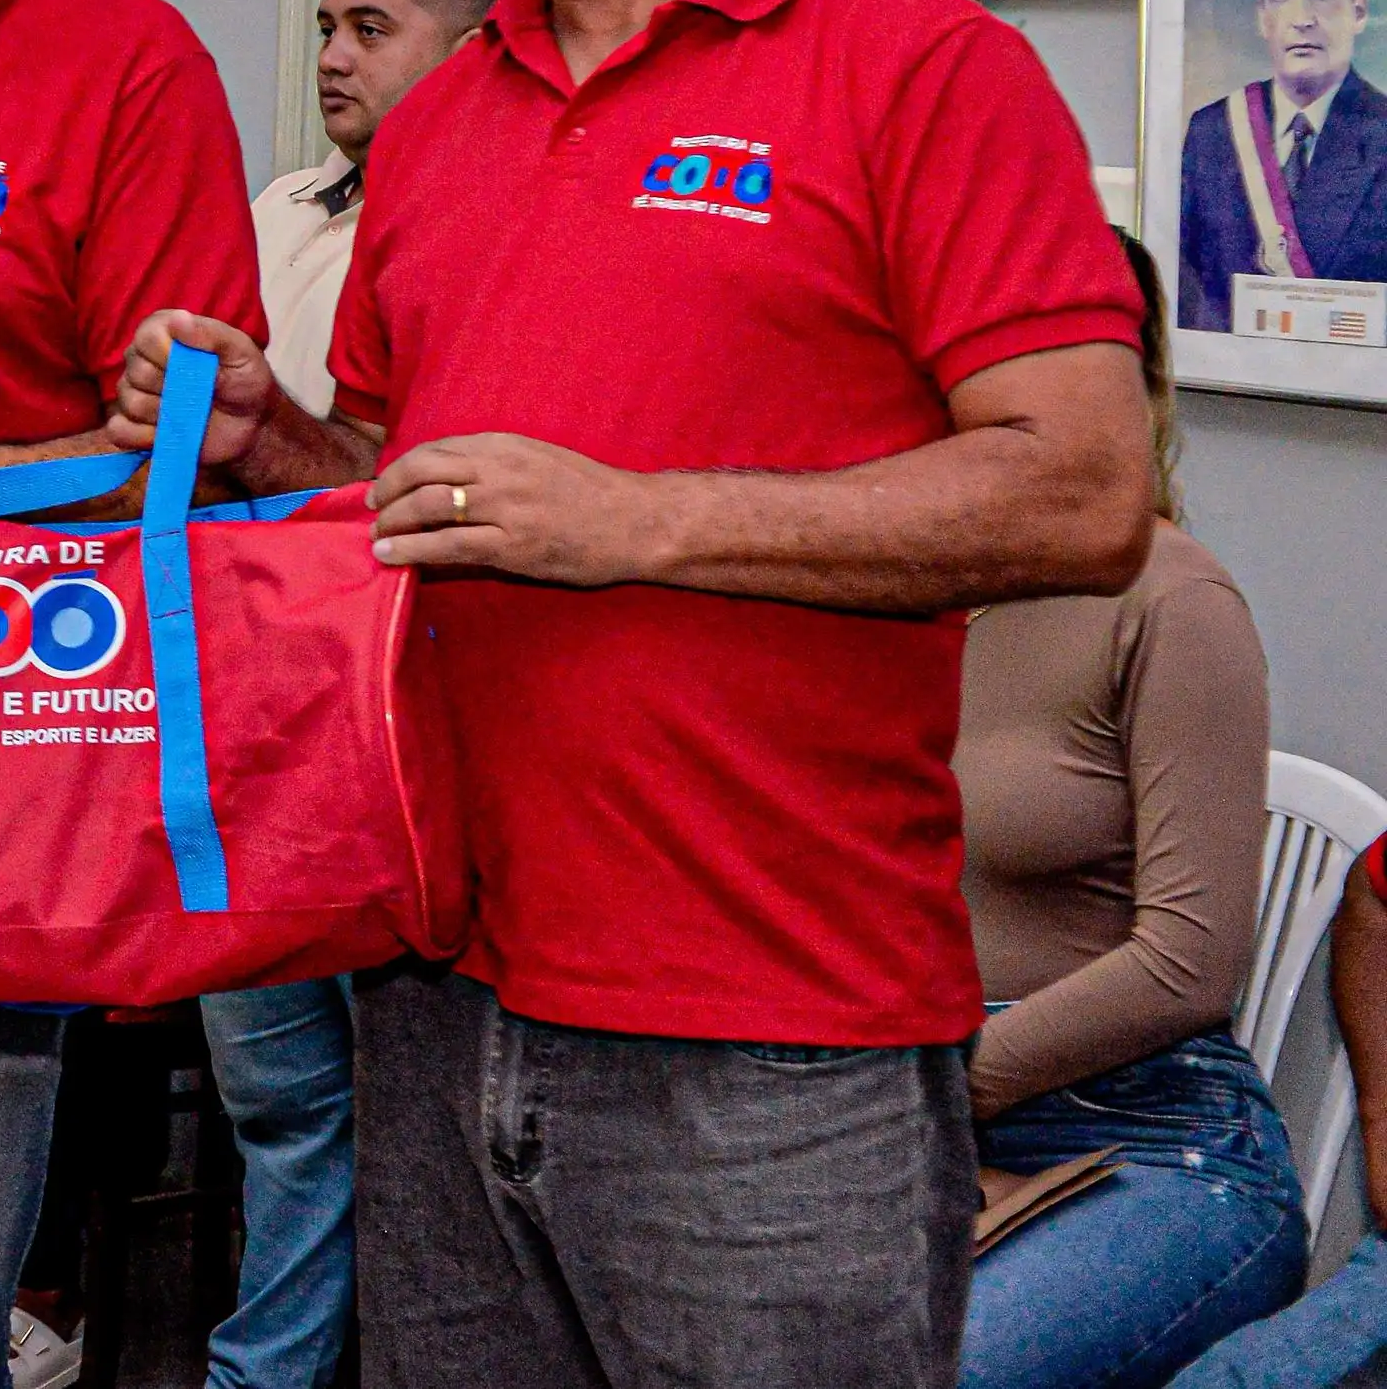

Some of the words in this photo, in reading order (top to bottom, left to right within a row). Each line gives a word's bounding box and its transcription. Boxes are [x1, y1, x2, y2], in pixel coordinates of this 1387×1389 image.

[58, 540, 105, 564] DE
[2, 691, 24, 716] E
[31, 687, 156, 715] FUTURO
[1, 727, 82, 746] ESPORTE
[85, 726, 99, 743] E
[100, 725, 156, 744] LAZER
